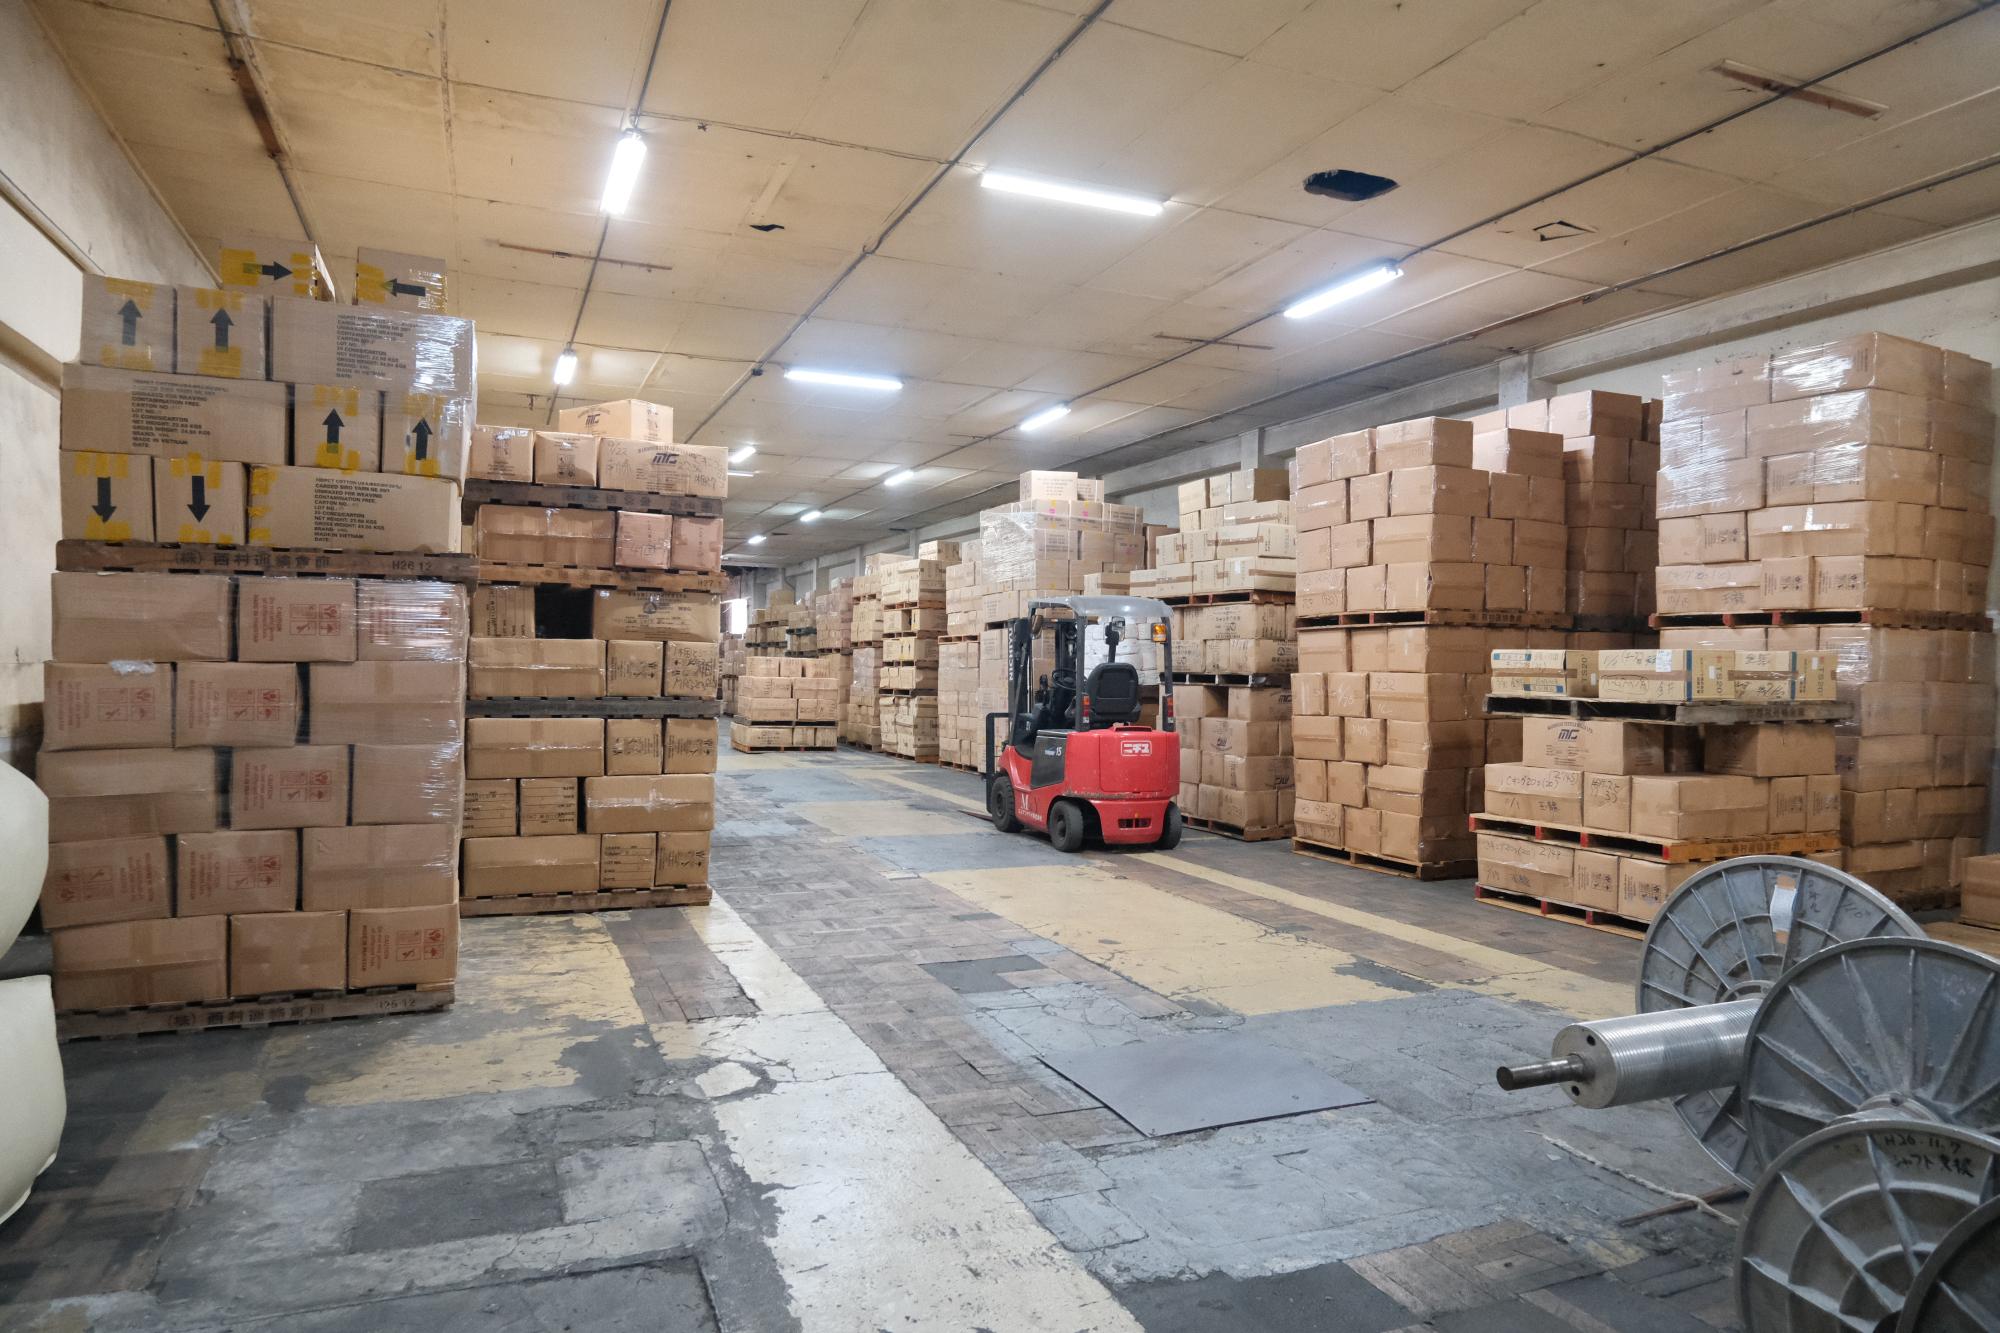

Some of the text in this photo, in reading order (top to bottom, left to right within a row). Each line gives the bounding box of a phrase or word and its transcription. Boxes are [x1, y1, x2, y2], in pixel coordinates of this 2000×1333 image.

[1056, 747, 1062, 756] 15
[1124, 743, 1150, 754] ニチユ
